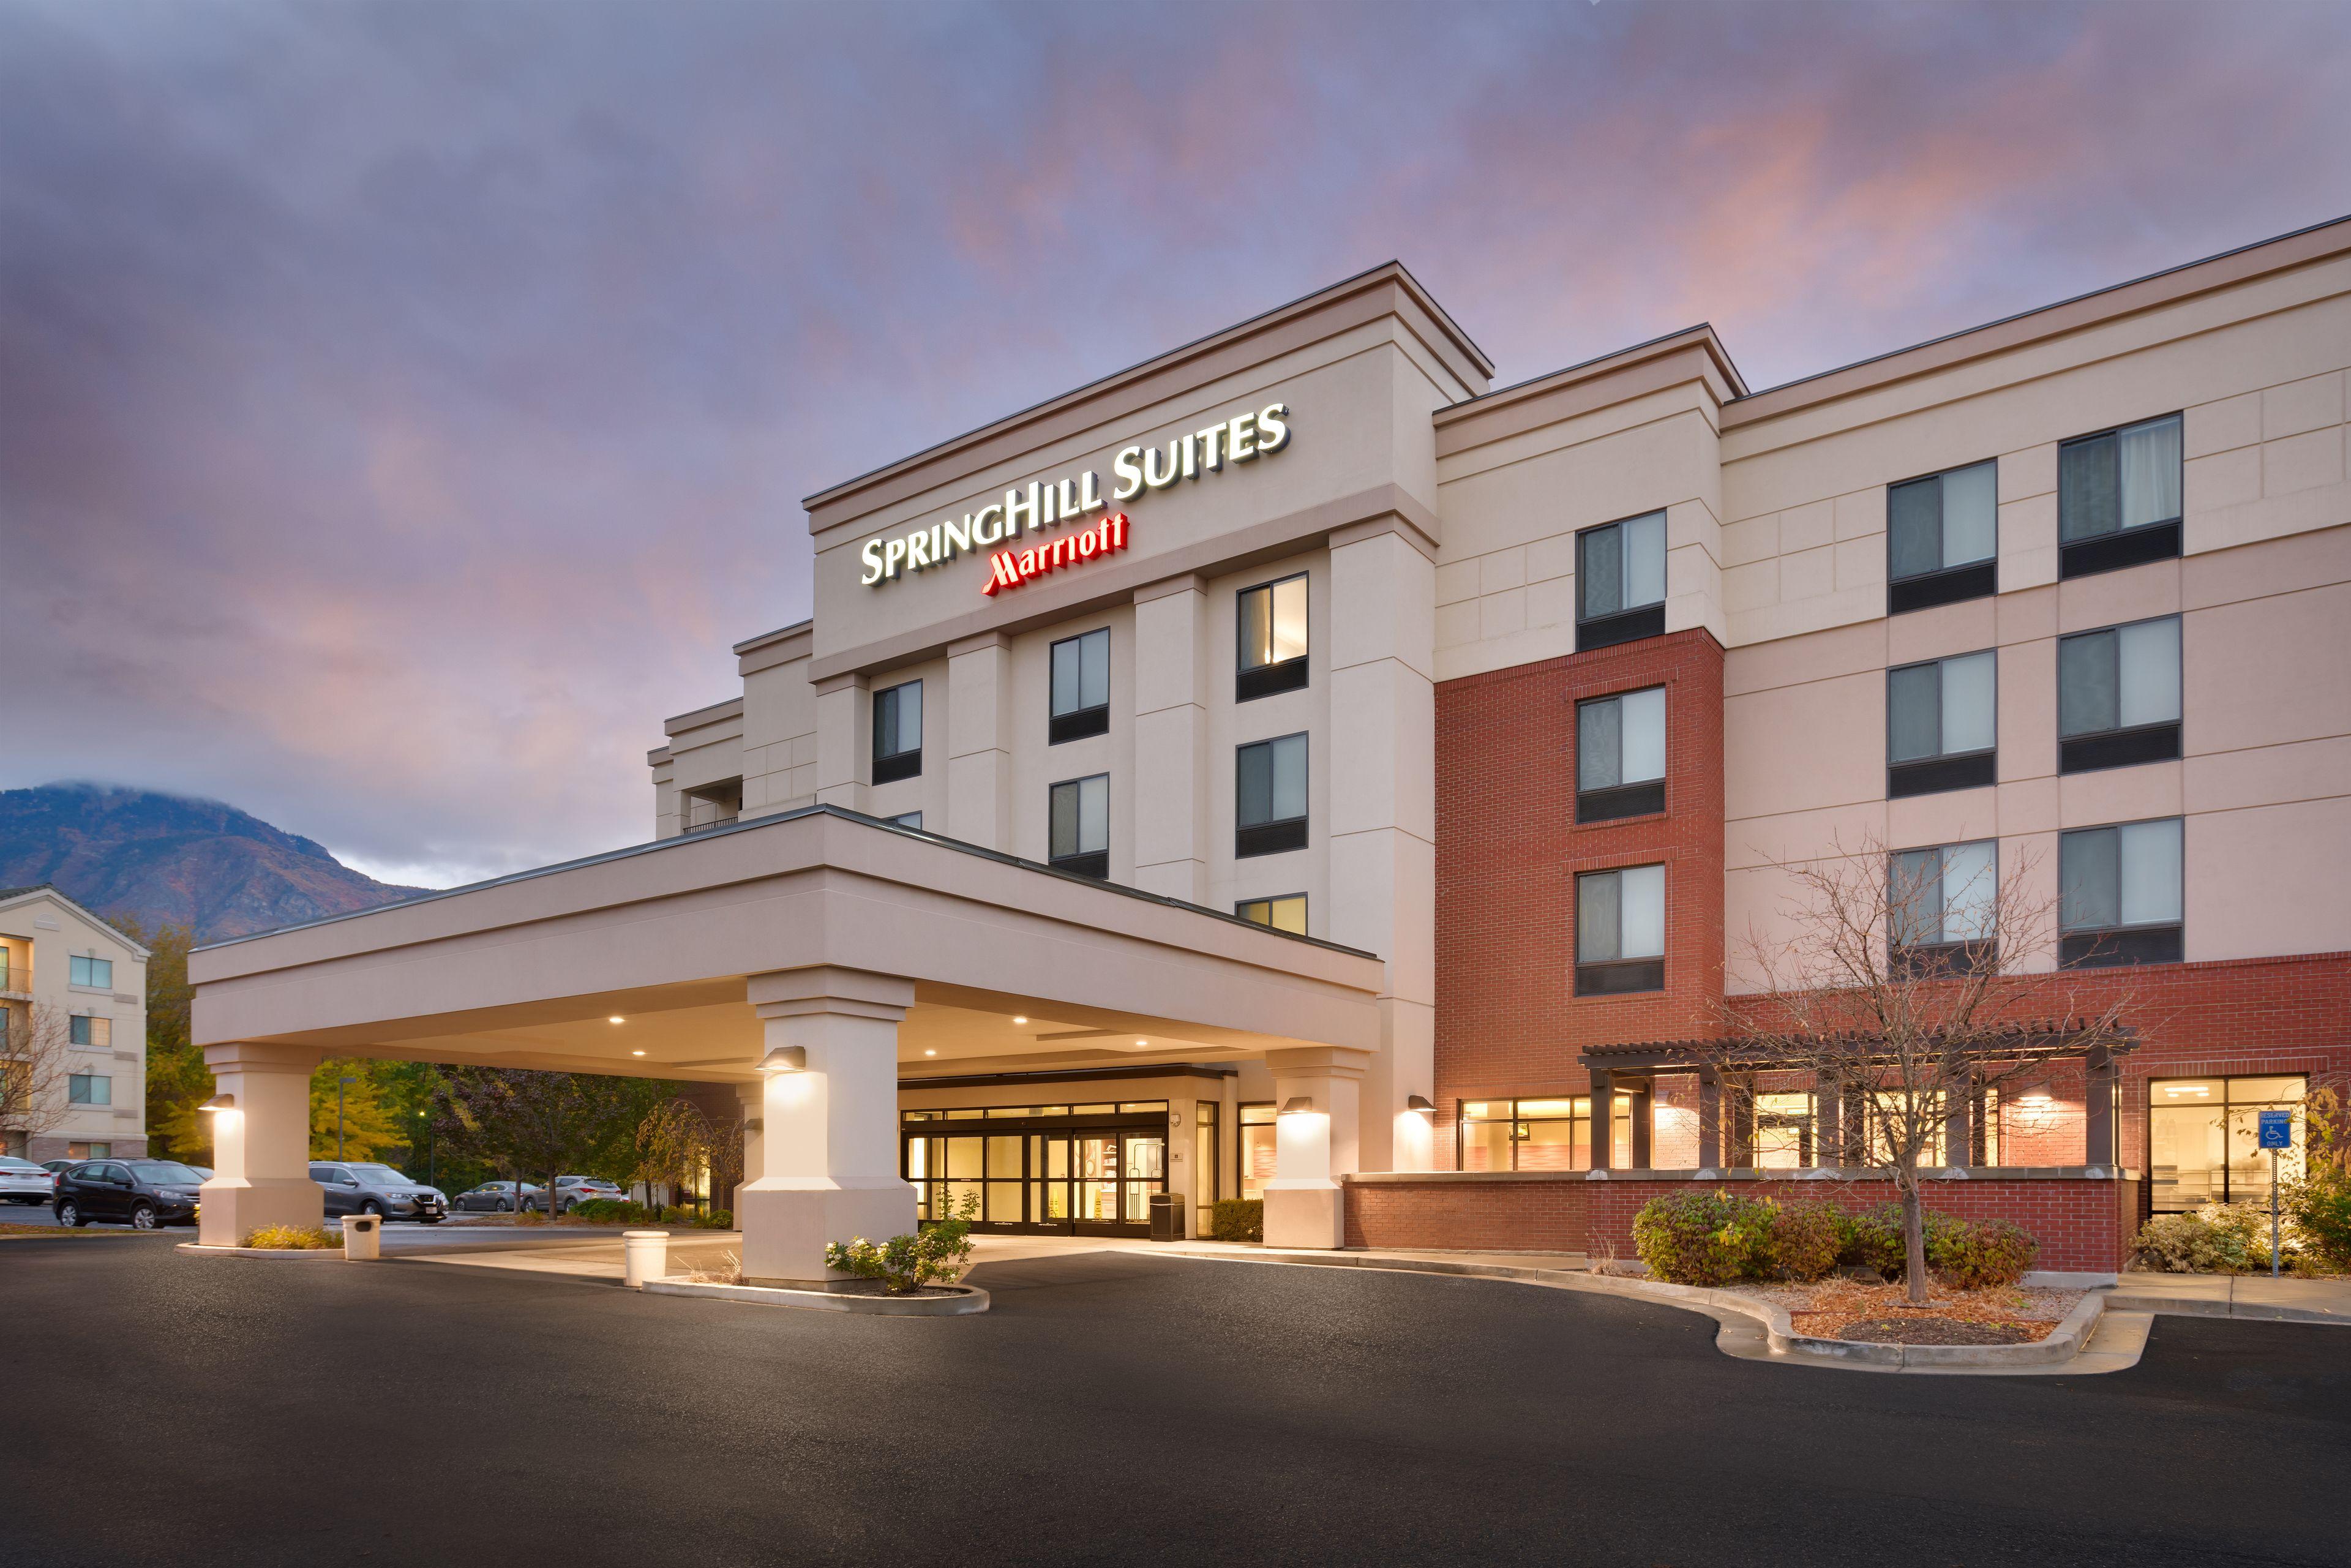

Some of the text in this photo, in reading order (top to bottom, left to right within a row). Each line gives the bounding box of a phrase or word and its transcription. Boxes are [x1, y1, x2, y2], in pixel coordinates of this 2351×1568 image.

[861, 403, 1289, 586] SPRINGHILL SUITES
[982, 512, 1131, 596] Marriott
